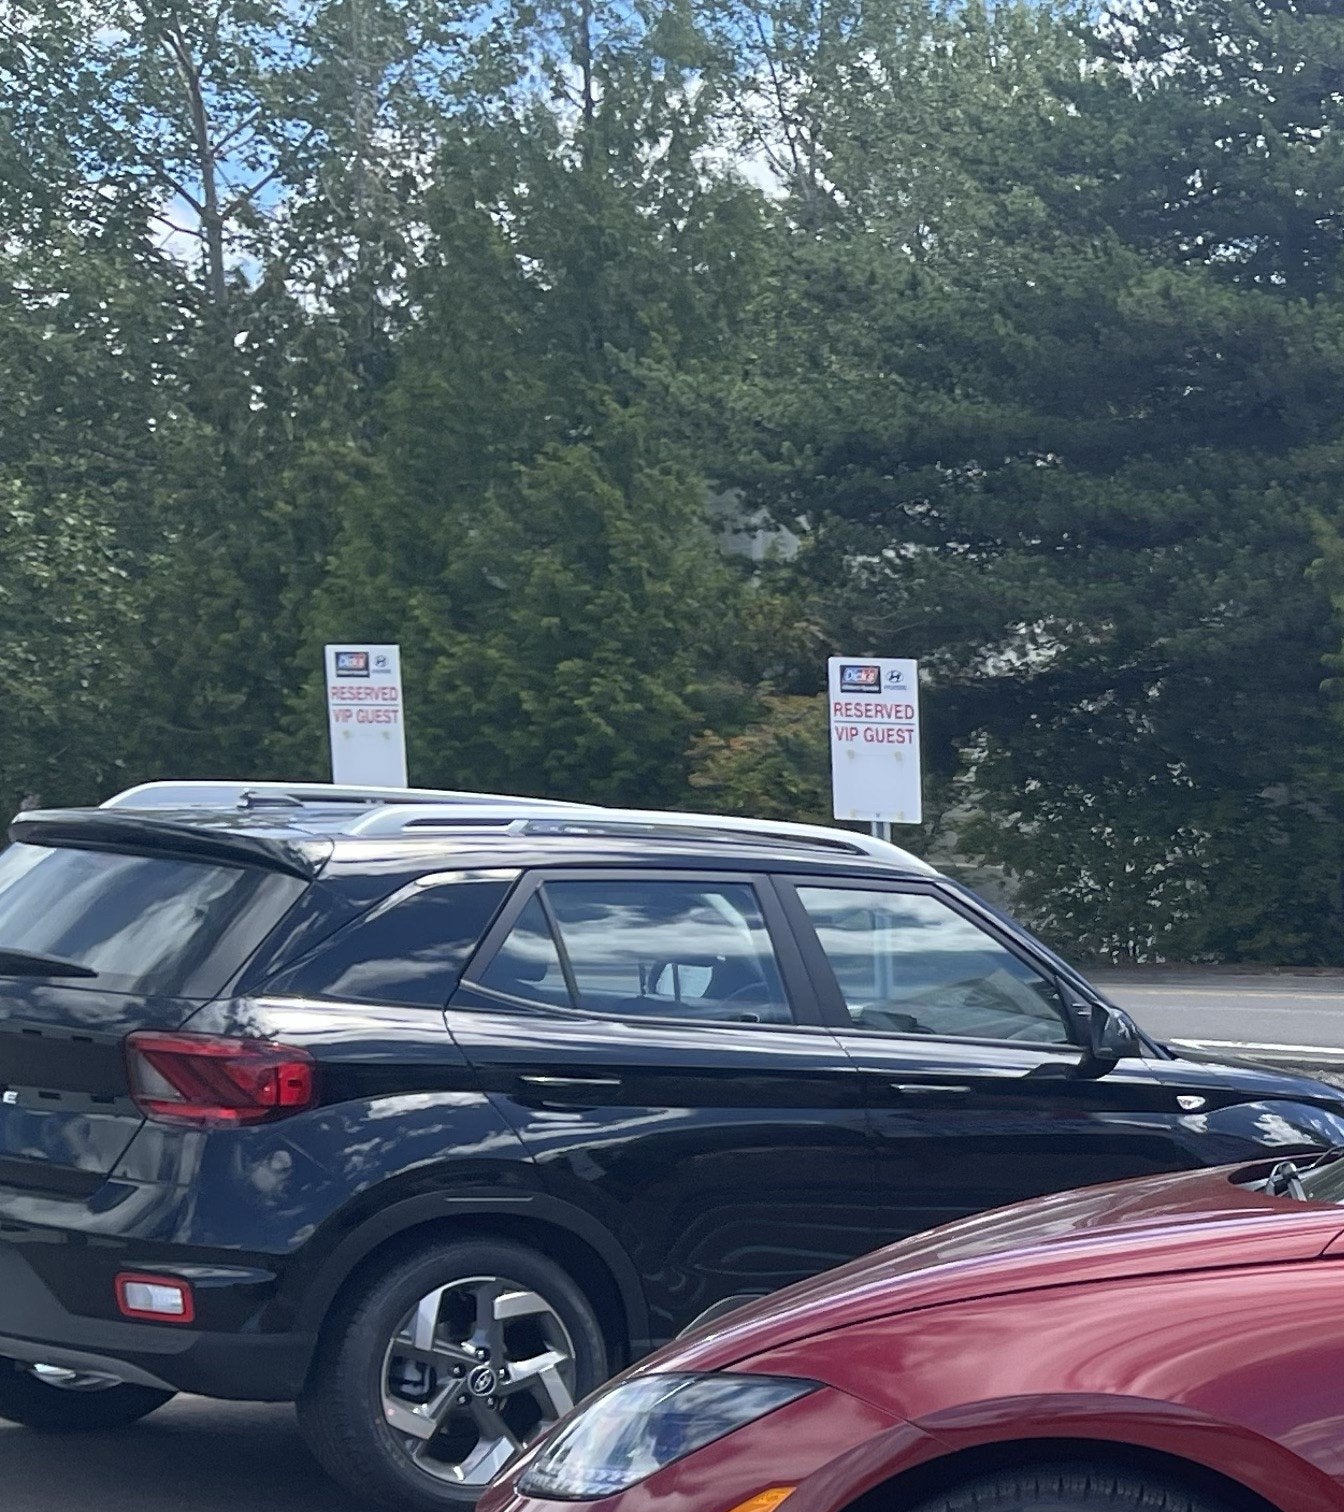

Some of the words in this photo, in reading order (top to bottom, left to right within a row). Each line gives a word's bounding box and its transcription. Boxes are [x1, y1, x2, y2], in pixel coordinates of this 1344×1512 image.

[331, 686, 399, 701] RESERVED
[333, 709, 353, 723] VIP
[356, 709, 399, 724] GUEST
[833, 702, 915, 720] RESERVED
[835, 726, 859, 742] VIP
[864, 727, 915, 744] GUEST
